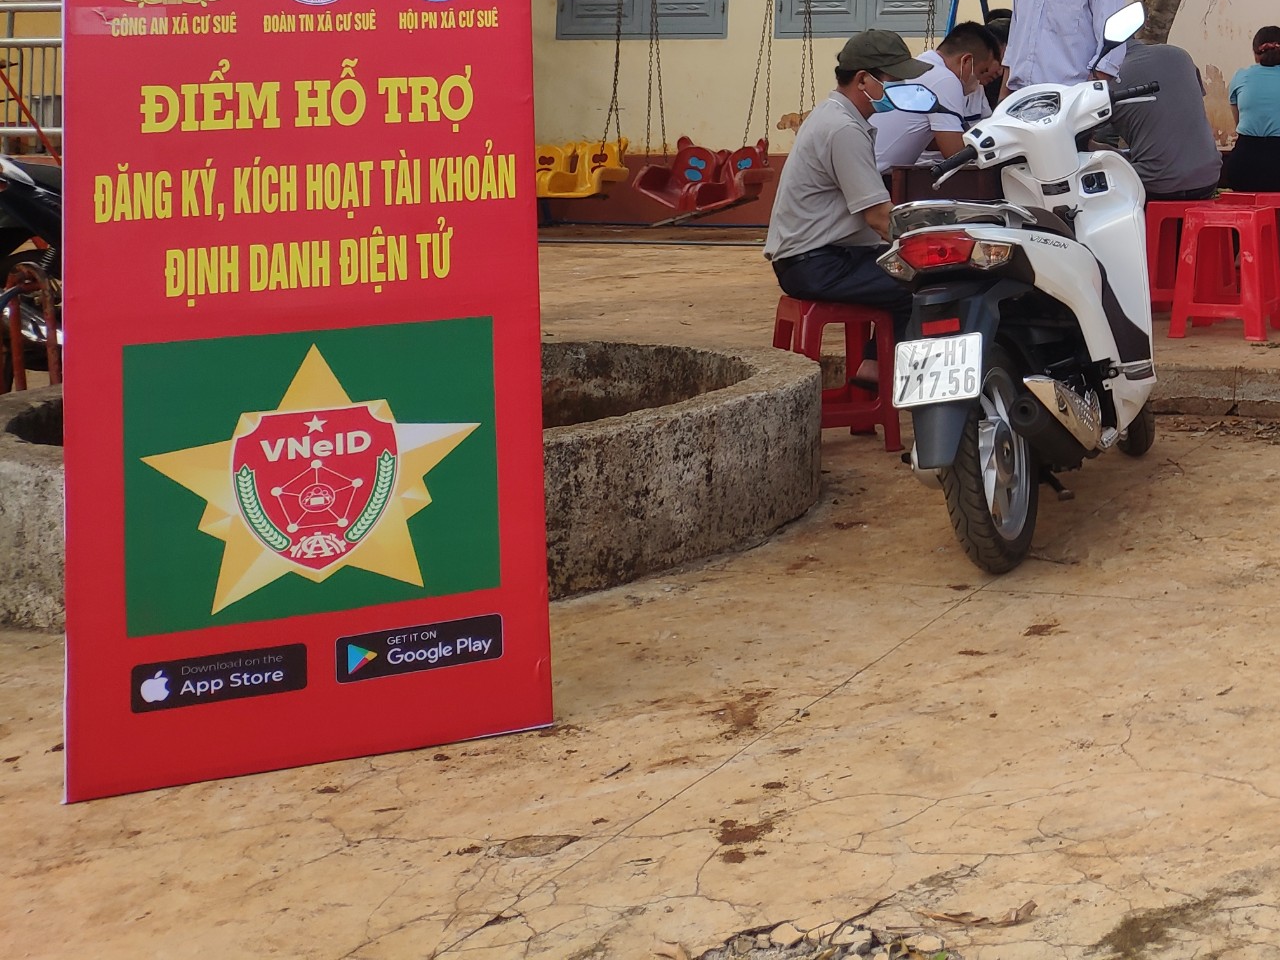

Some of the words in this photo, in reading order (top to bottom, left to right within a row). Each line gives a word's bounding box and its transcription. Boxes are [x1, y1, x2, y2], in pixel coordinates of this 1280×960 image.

[111, 13, 147, 37] CÔNG
[150, 17, 168, 36] AN
[172, 12, 189, 35] XÃ
[192, 13, 211, 35] CƯ
[213, 11, 238, 34] SUÊ
[263, 10, 296, 34] ĐOÀN
[298, 13, 314, 32] TN
[317, 10, 333, 32] XÃ
[336, 10, 353, 32] CƯ
[354, 8, 377, 31] SUÊ
[398, 8, 419, 34] HỘI
[421, 11, 438, 30] PN
[441, 7, 456, 29] XÃ
[458, 8, 475, 28] CƯ
[477, 6, 499, 28] SUÊ
[139, 58, 281, 134] ĐIỂM
[294, 57, 367, 128] HỖ
[377, 64, 474, 133] TRỢ
[93, 162, 173, 224] ĐĂNG
[181, 158, 225, 222] KÝ,
[233, 156, 297, 215] KÍCH
[306, 160, 374, 220] HOẠT
[380, 149, 421, 206] TÀI
[429, 138, 516, 204] KHOẢN
[1029, 234, 1069, 249] VISION
[164, 244, 240, 308] ĐỊNH
[249, 240, 331, 292] DANH
[338, 226, 408, 294] ĐIỆN
[415, 216, 454, 280] TỬ
[907, 338, 967, 371] 47-H1
[898, 366, 976, 402] 717.56
[259, 430, 372, 462] VNeID
[386, 634, 408, 645] GET
[409, 632, 419, 642] IT
[420, 630, 437, 641] ON
[386, 641, 453, 665] Google
[456, 636, 493, 655] Play
[181, 658, 242, 676] Download
[244, 658, 260, 667] on
[263, 654, 284, 664] the
[179, 677, 224, 697] App
[229, 669, 285, 688] Store
